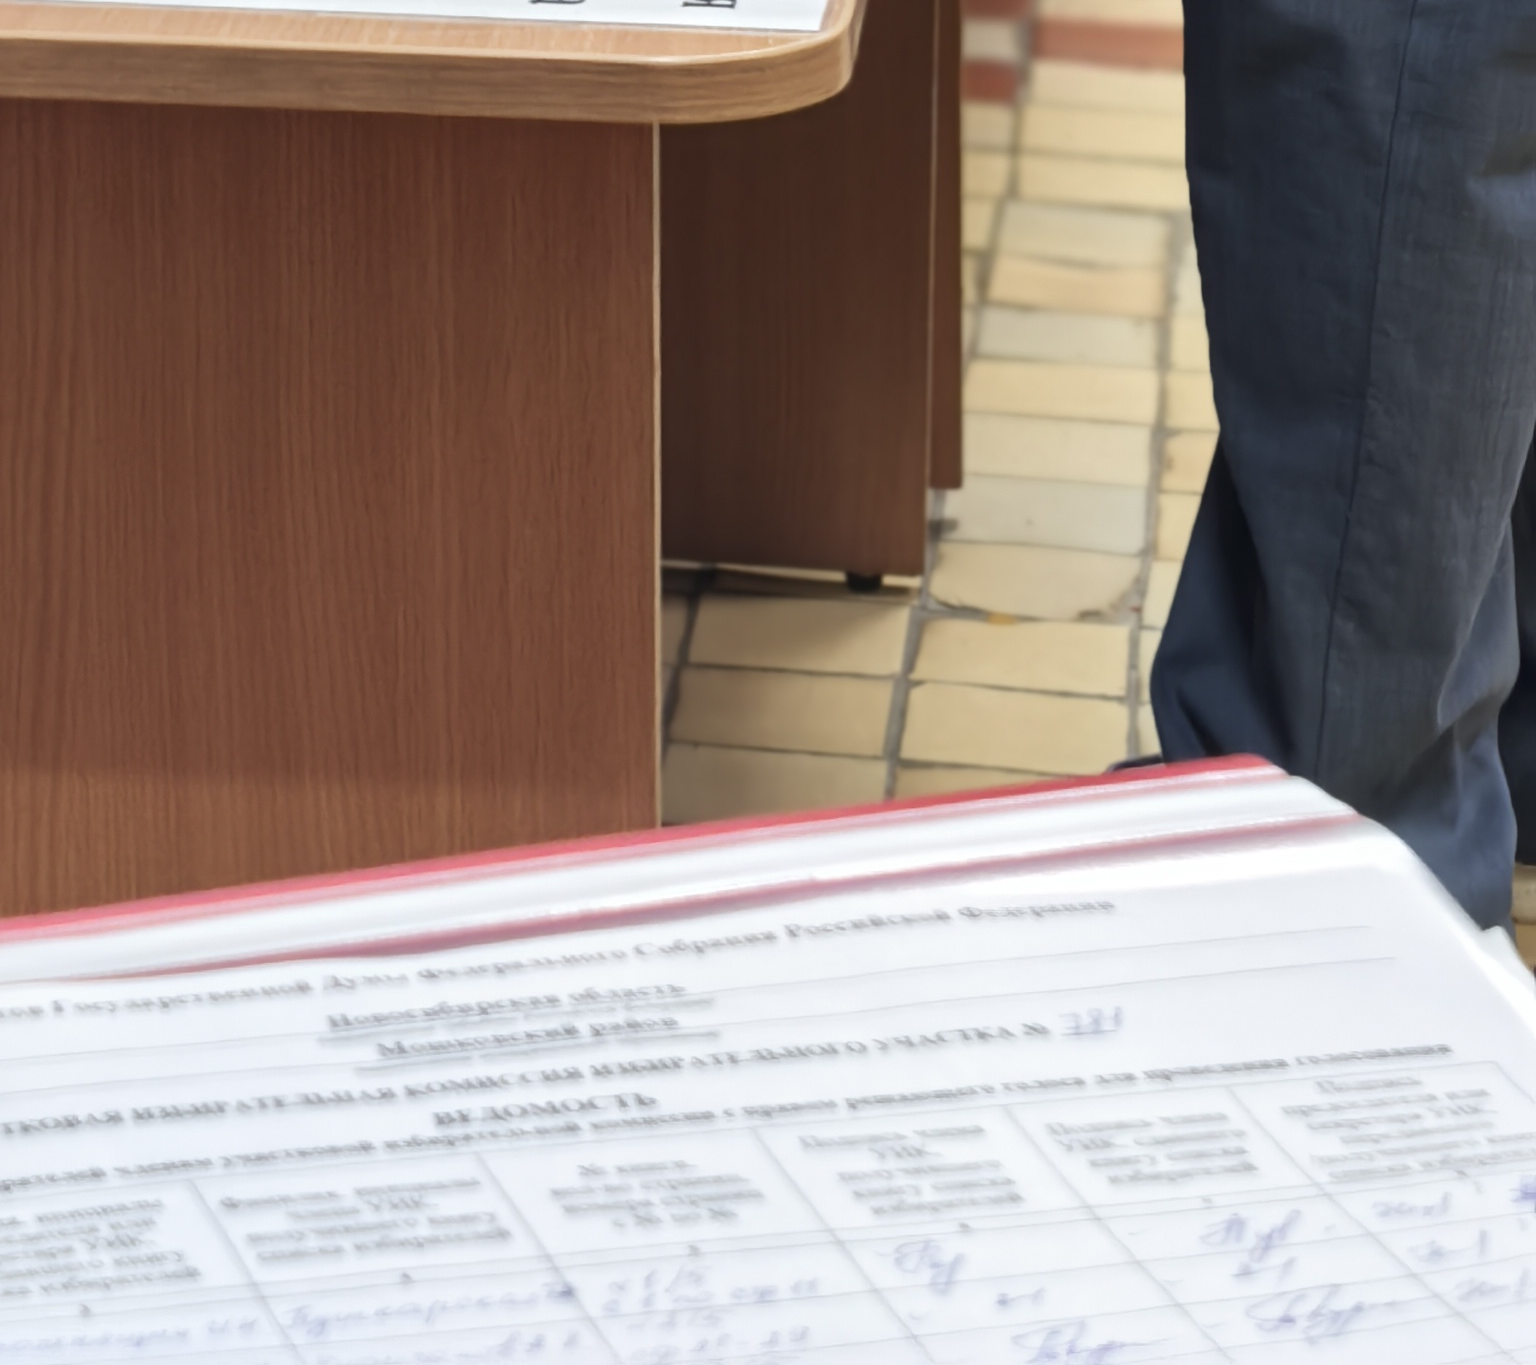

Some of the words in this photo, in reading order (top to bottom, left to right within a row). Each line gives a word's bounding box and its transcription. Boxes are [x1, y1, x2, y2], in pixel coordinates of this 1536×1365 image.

[403, 1066, 586, 1100] КОМИССИЯ
[872, 1026, 1016, 1052] УЧАСТКА
[433, 1092, 659, 1127] ВЕДОМОСТЬ
